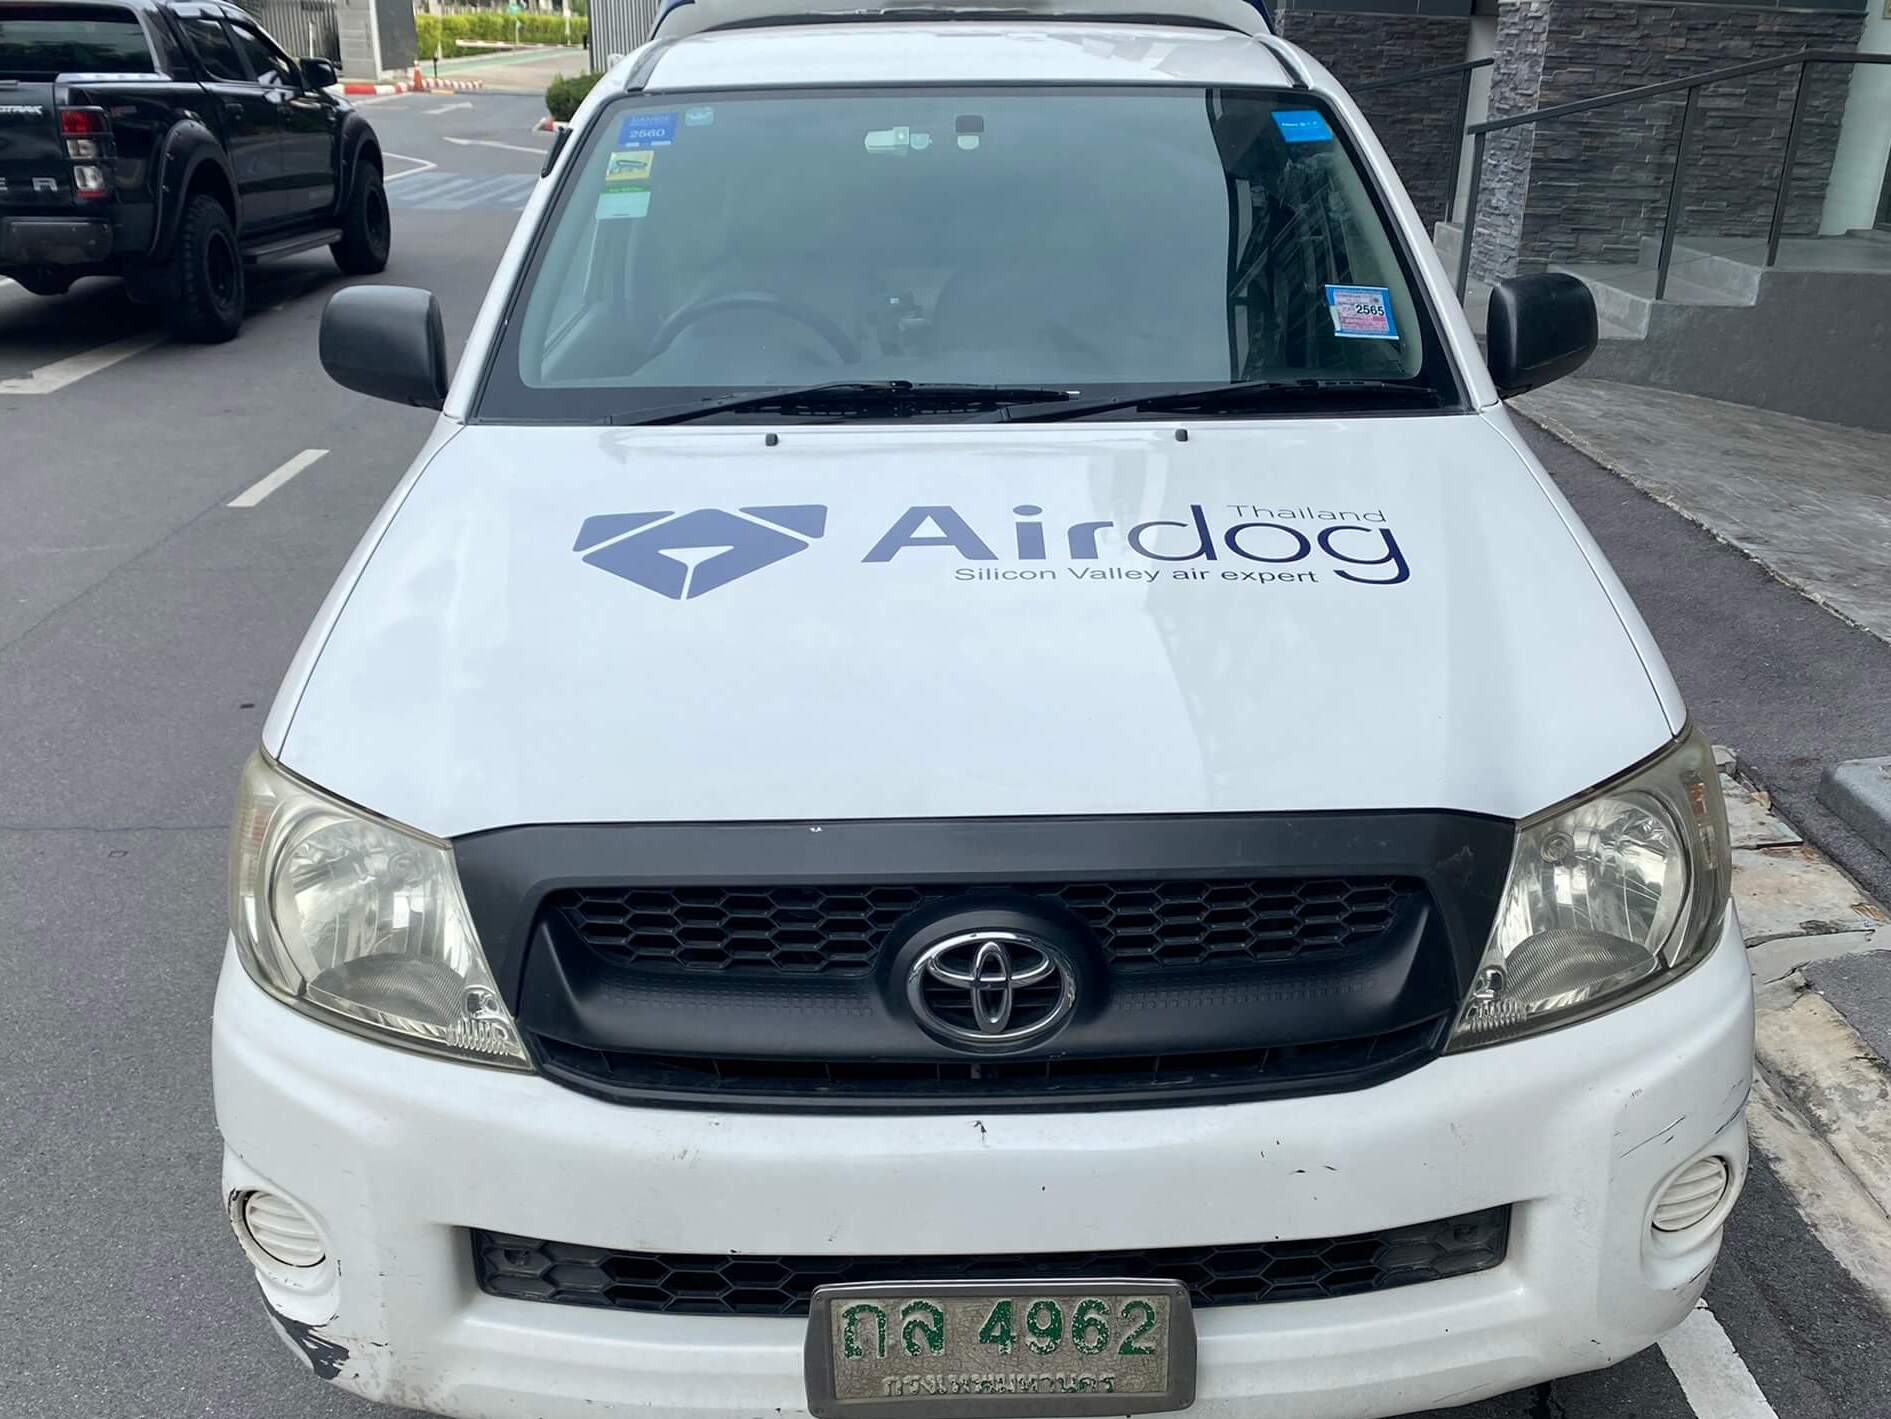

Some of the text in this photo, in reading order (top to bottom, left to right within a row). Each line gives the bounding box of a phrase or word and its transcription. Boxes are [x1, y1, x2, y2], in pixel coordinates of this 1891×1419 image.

[1355, 303, 1385, 316] 2565
[1227, 504, 1387, 523] Thailand
[860, 503, 1410, 585] Airdog
[954, 567, 1320, 585] Silicon Valley air expert
[977, 1298, 1156, 1357] 4962
[880, 1372, 1116, 1397] กรงเทพมหานคร
